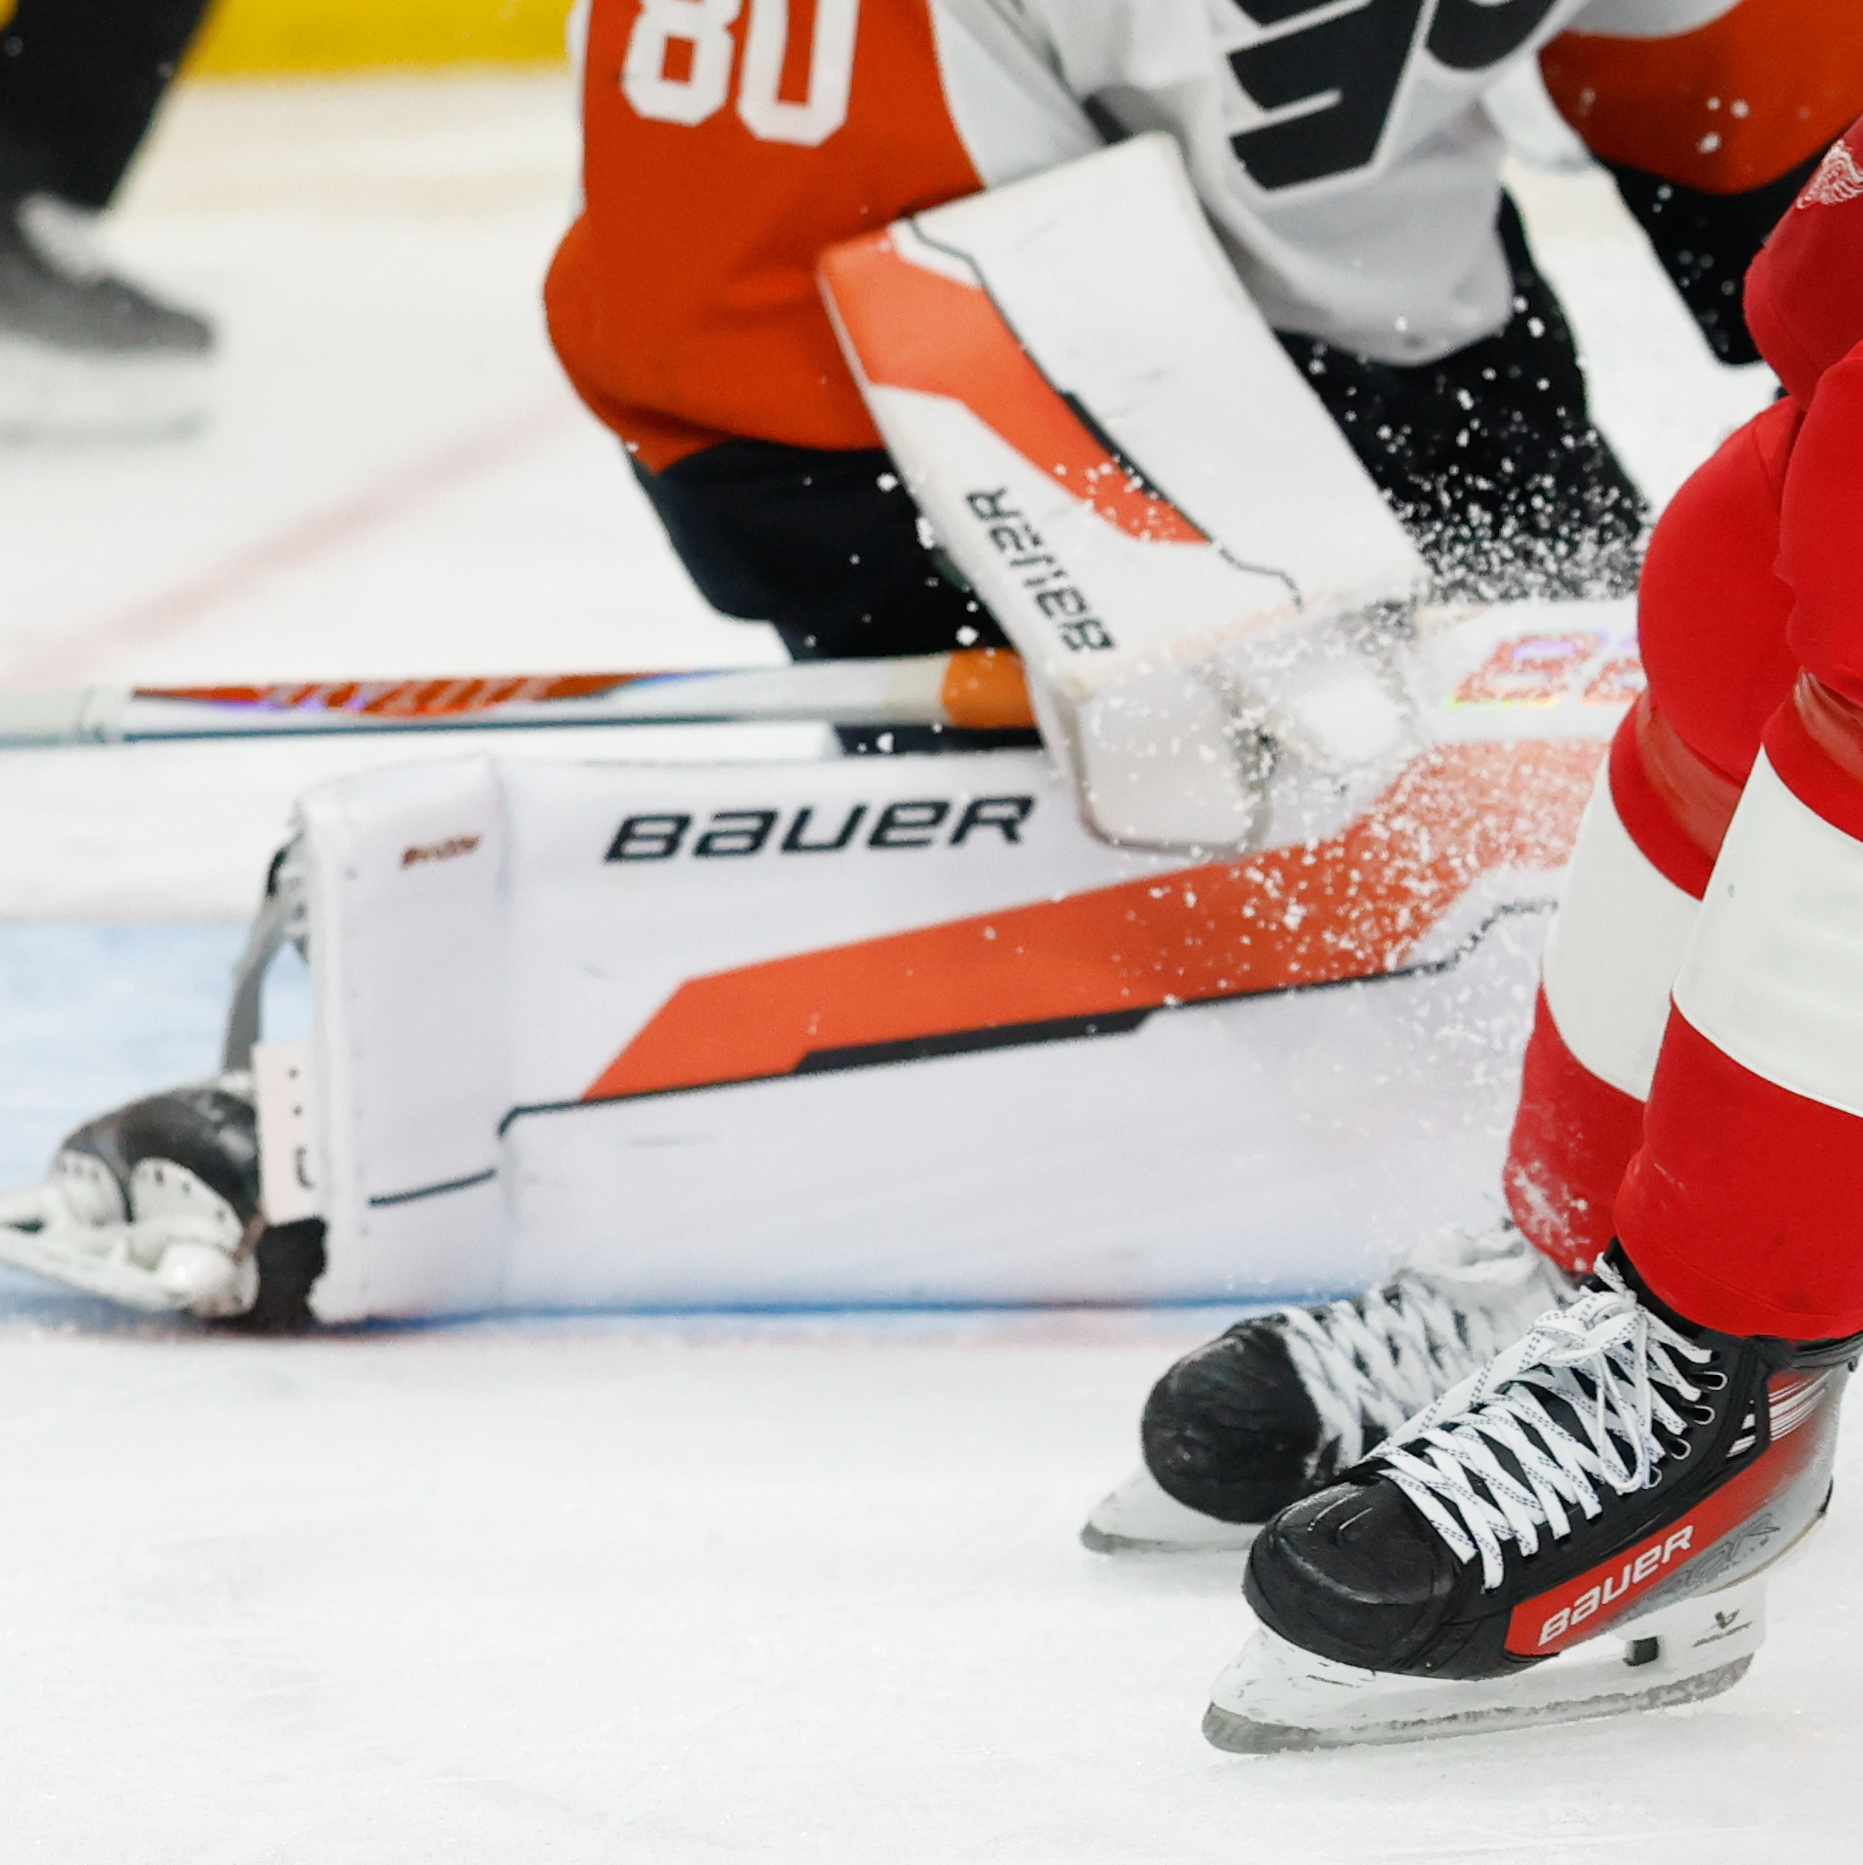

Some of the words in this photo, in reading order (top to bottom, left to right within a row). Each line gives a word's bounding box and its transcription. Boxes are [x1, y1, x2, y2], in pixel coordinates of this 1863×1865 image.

[965, 486, 1118, 652] BAUER
[603, 794, 1037, 864] BAUER
[1537, 1524, 1694, 1648] BAUER
